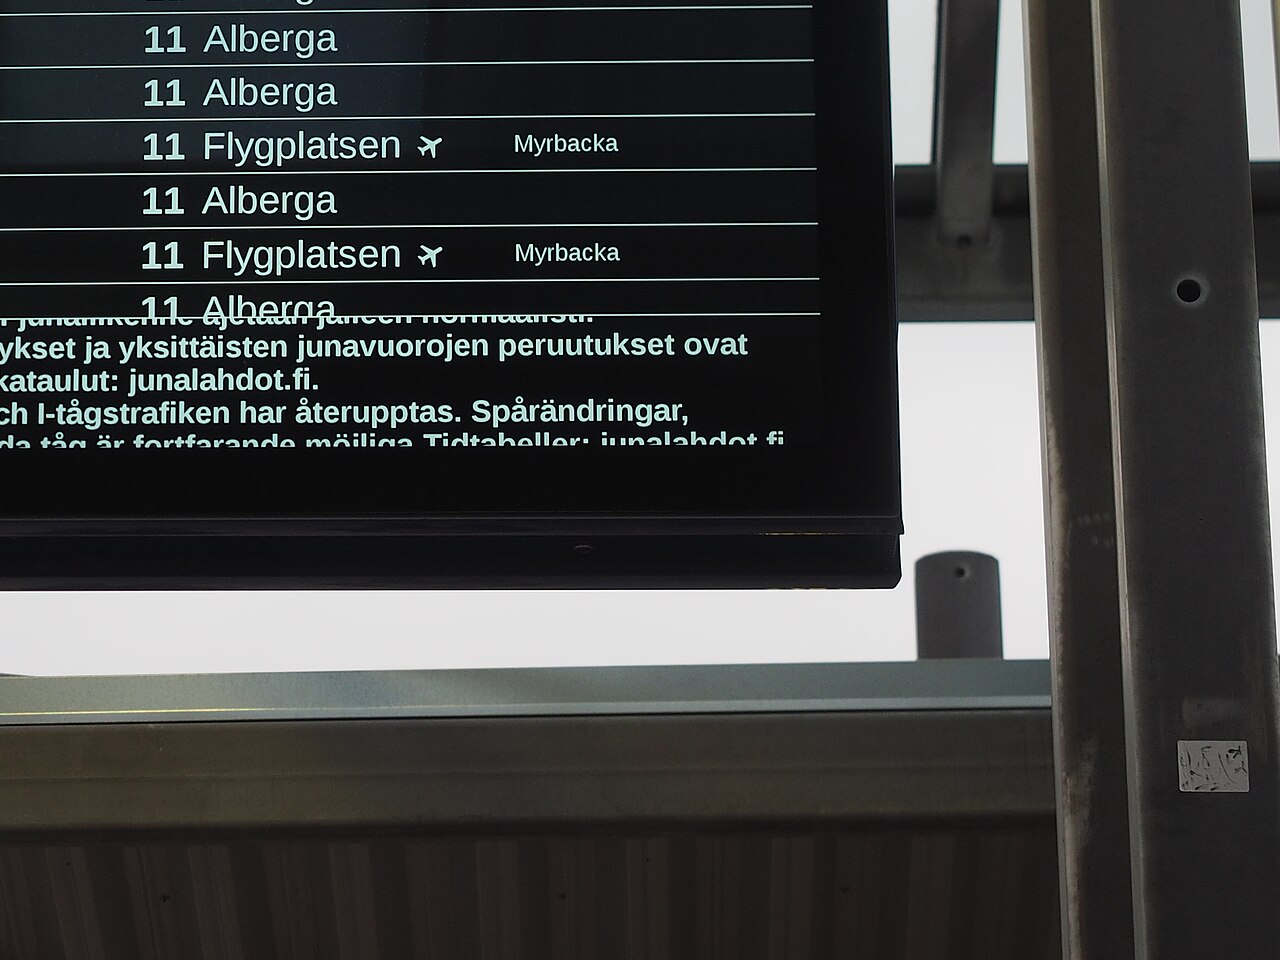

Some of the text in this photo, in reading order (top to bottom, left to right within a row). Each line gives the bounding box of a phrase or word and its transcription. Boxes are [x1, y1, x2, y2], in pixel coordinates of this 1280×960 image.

[145, 26, 186, 52] 11
[204, 24, 338, 58] Alberga
[145, 80, 185, 106] 11
[203, 78, 337, 112] Alberga
[144, 133, 184, 160] 11
[205, 131, 399, 166] Flygplatsen
[515, 134, 618, 156] Myrbacka
[143, 187, 184, 214] 11
[202, 186, 337, 220] Alberga
[142, 242, 183, 269] 11
[204, 240, 400, 276] Flygplatsen
[516, 243, 620, 266] Myrbacka
[141, 296, 178, 318] 11
[84, 336, 111, 364] ja
[119, 335, 287, 364] yksittäisten
[296, 334, 488, 362] junavuorojen
[500, 333, 674, 361] peruutukset
[685, 334, 748, 355] ovat
[128, 368, 318, 396] junalahdot.fi.
[39, 399, 229, 430] I-tågstrafiken
[241, 401, 286, 423] har
[296, 398, 460, 428] återupptas.
[472, 396, 687, 427] Spårändringar,
